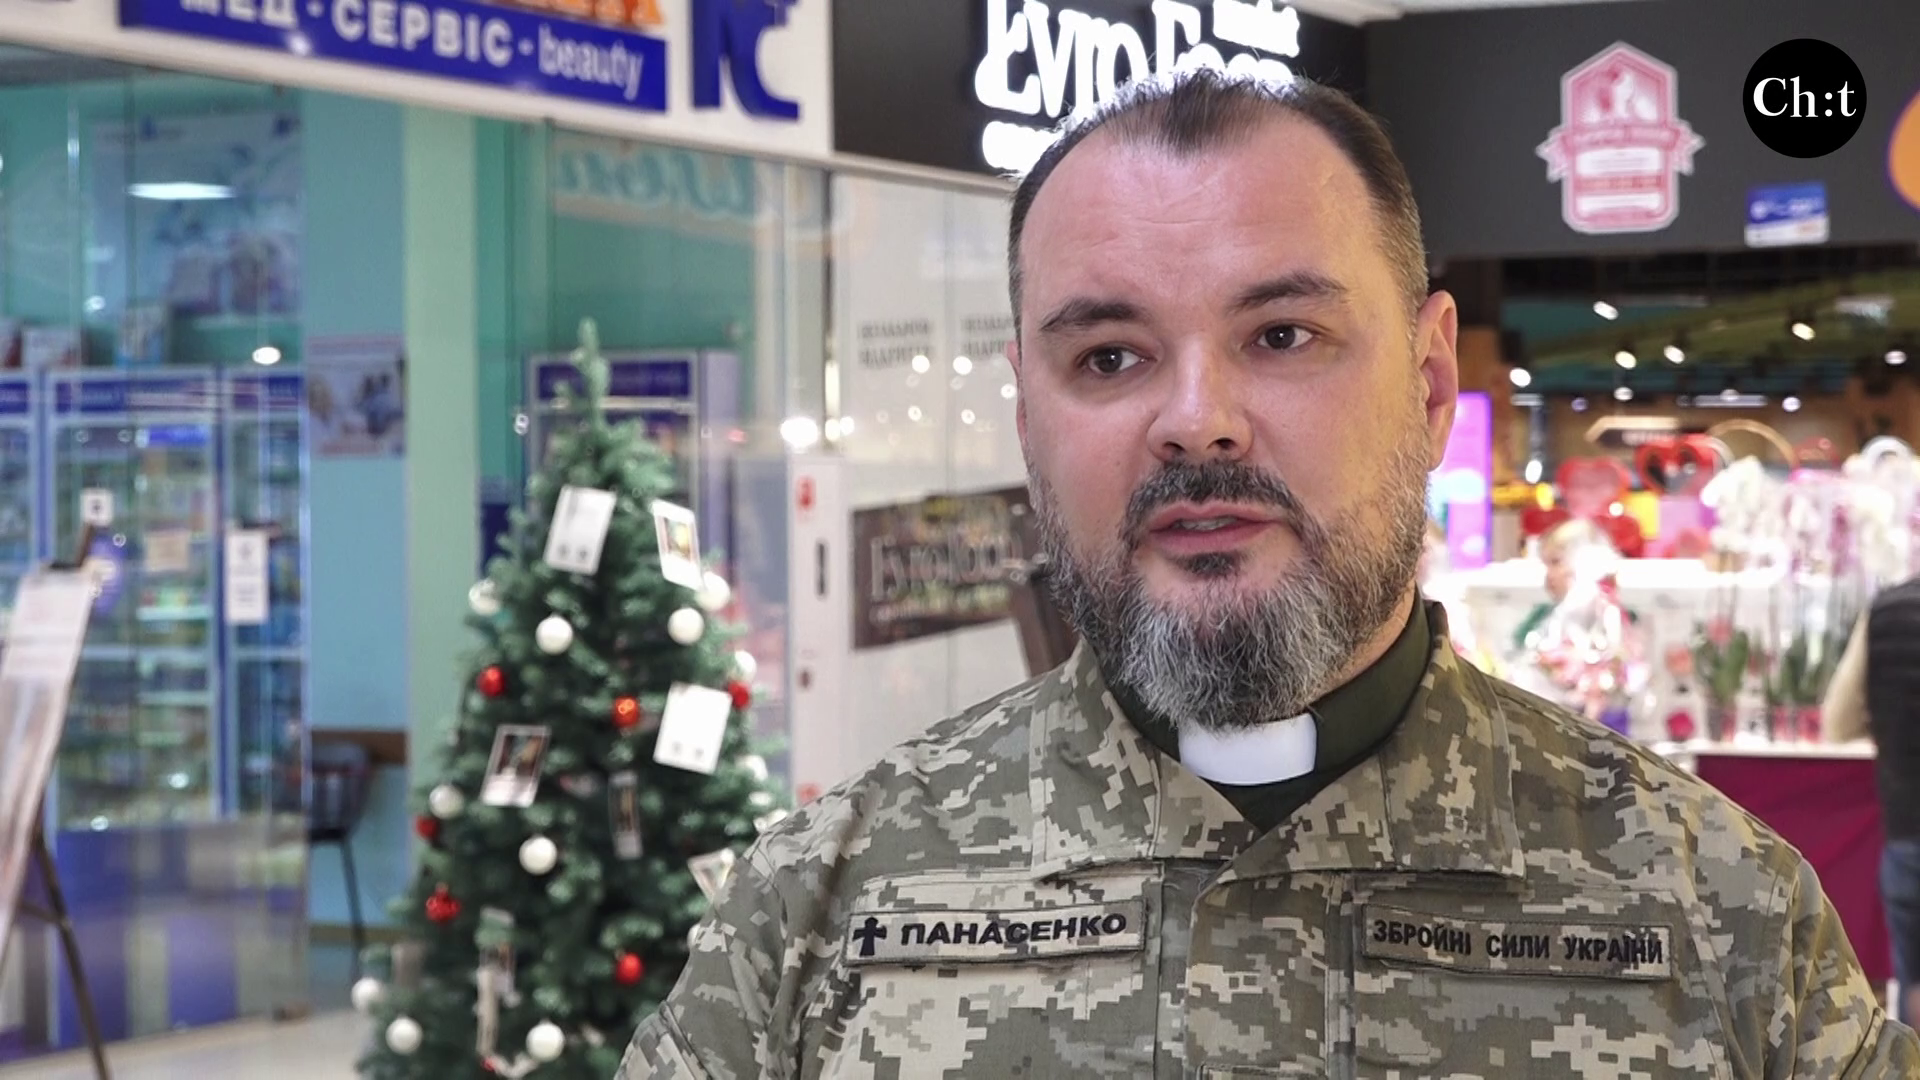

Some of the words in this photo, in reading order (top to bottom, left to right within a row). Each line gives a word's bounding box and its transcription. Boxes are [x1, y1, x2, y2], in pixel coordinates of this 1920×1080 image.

[330, 0, 513, 67] СЕРВІС
[538, 22, 643, 100] beauty
[901, 913, 1127, 946] ПАНАСЕНКО
[1373, 919, 1471, 956] ЗБРОЙНІ
[1486, 934, 1550, 959] СИЛИ
[1563, 933, 1663, 964] УКРАЇНИ
